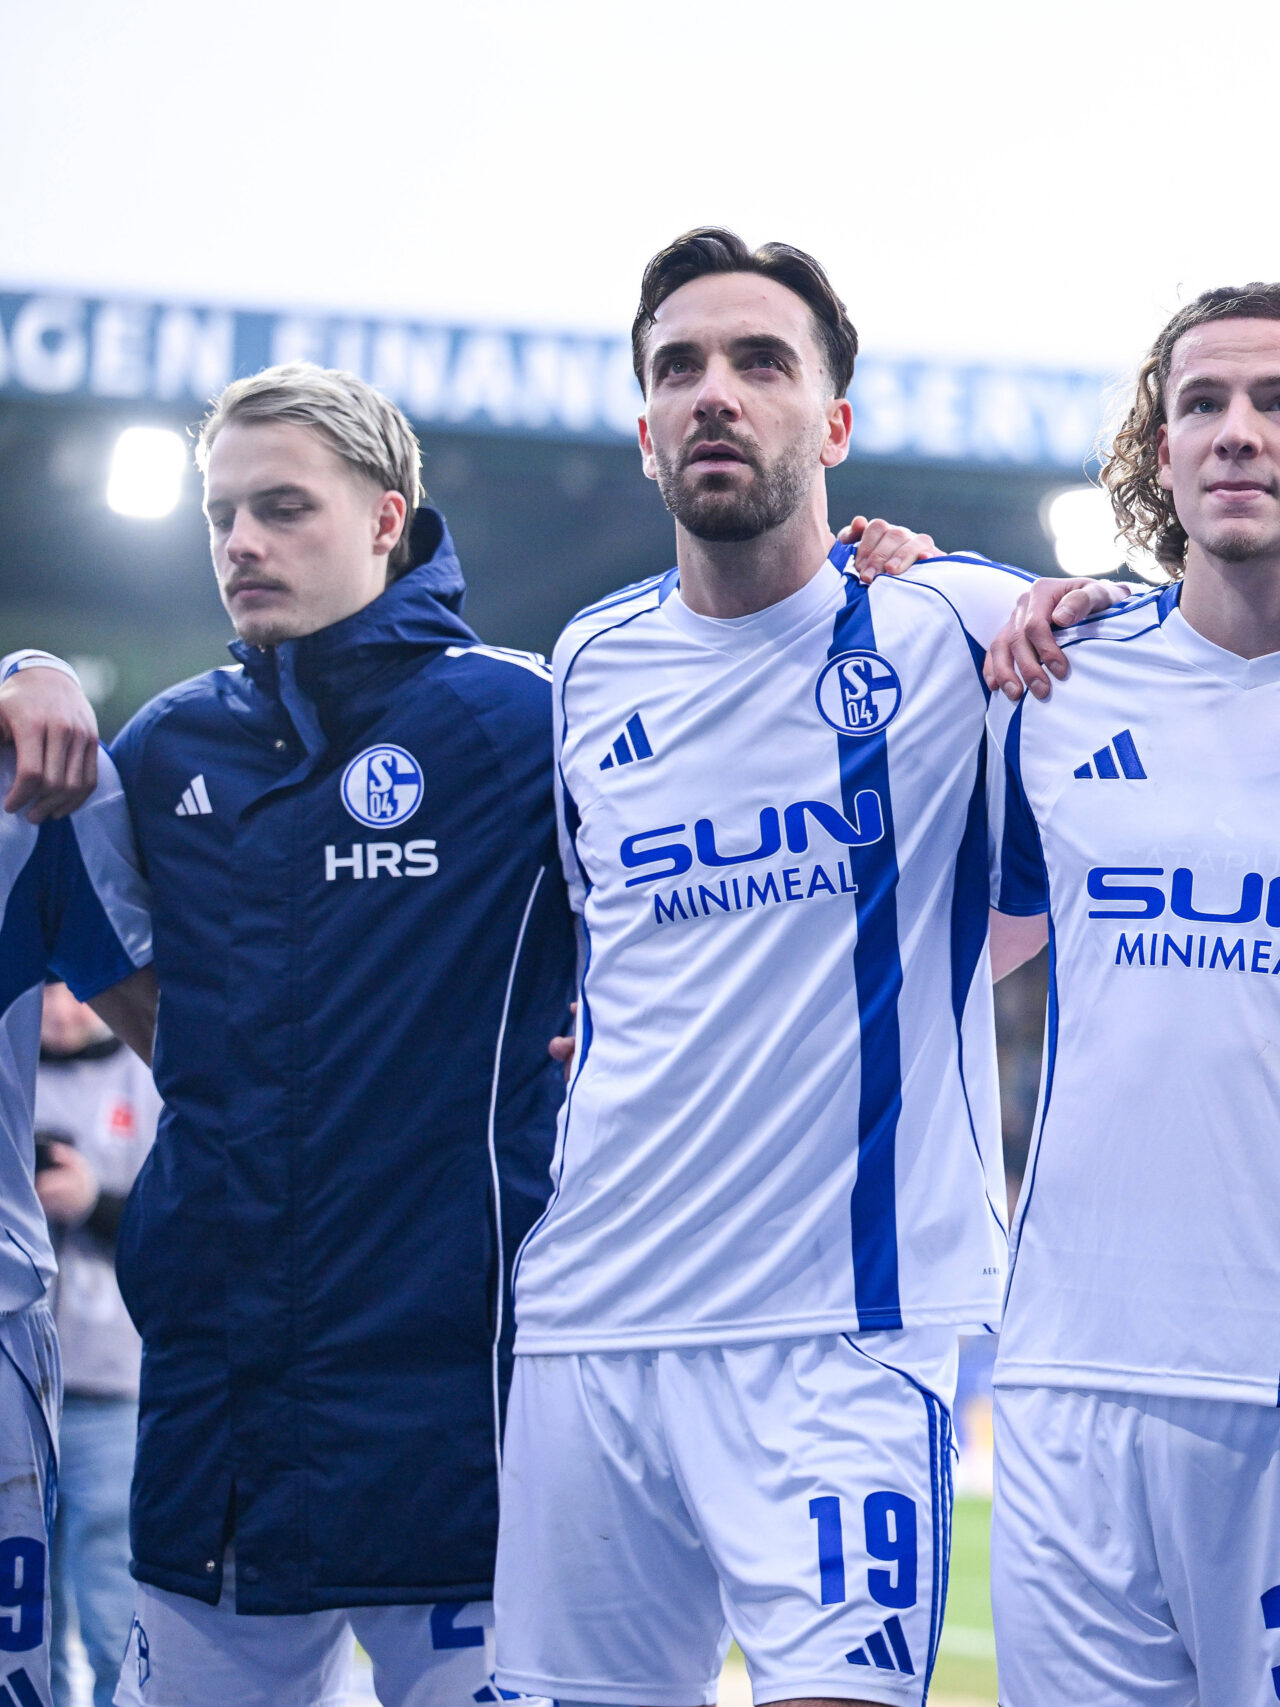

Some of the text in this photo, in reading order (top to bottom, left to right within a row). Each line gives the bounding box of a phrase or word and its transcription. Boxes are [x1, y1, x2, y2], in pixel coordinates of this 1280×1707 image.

[0, 297, 232, 402] GEN
[847, 700, 873, 727] 04
[369, 793, 394, 818] 04
[324, 838, 439, 881] HRS
[620, 789, 885, 889] SUN
[653, 861, 859, 925] MINIMEAL
[809, 1490, 918, 1610] 19
